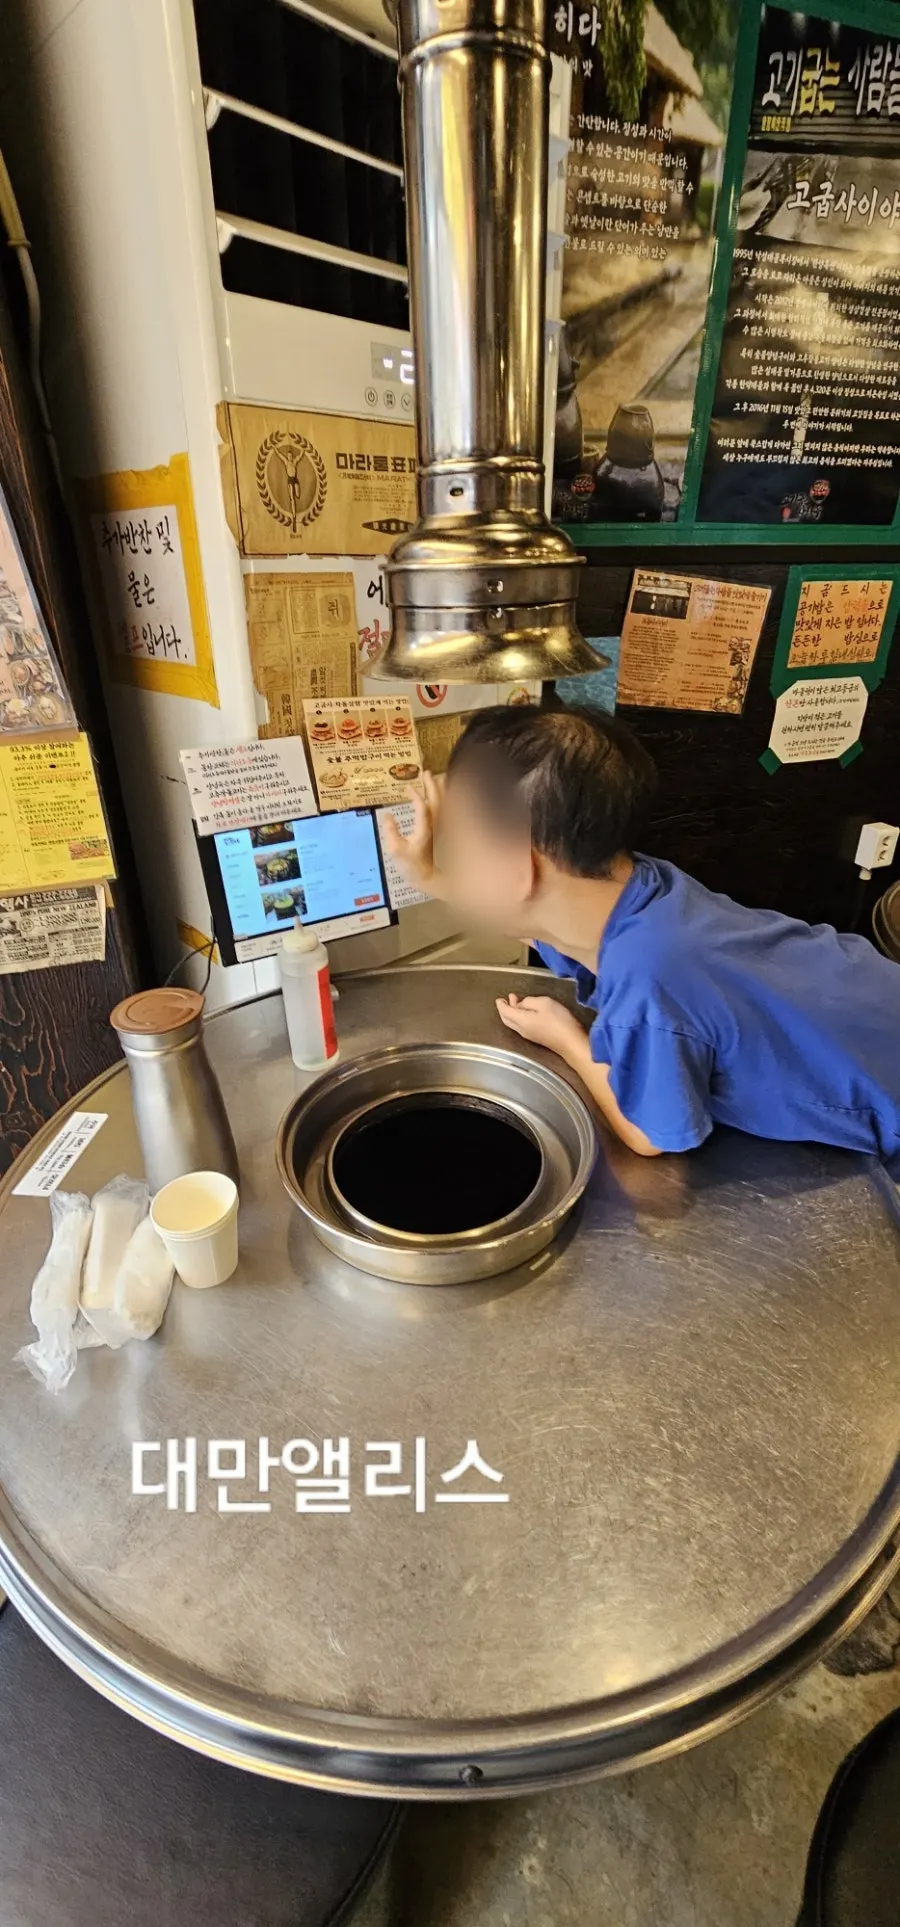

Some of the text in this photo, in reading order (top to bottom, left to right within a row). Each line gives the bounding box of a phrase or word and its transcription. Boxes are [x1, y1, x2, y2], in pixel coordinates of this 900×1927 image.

[554, 1, 602, 46] 히다
[582, 59, 593, 78] 맛
[761, 47, 840, 119] 고기굽는
[623, 121, 648, 138] 정성과
[649, 126, 672, 142] 시간이
[614, 145, 647, 163] 공간이기
[590, 168, 615, 183] 숙성한
[616, 171, 640, 186] 고기의
[733, 248, 753, 260] 1995년
[127, 570, 156, 608] 물은
